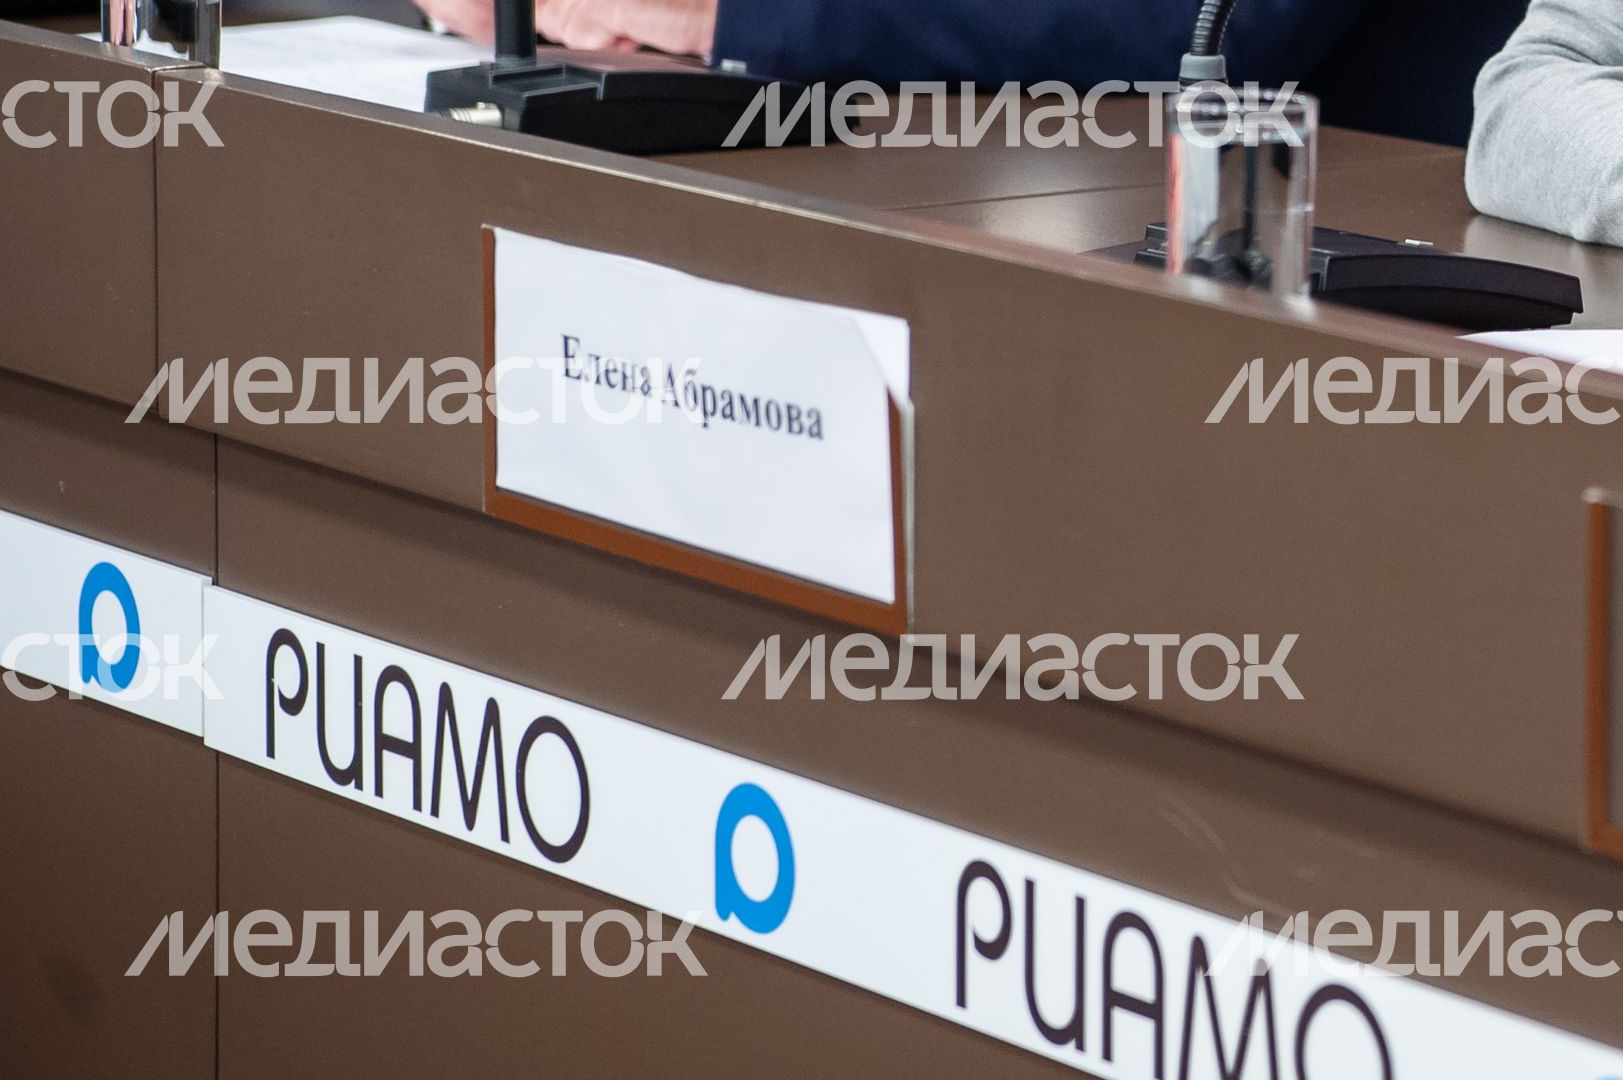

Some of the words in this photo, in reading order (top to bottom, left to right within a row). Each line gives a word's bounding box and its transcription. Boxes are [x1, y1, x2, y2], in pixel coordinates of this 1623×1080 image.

[560, 333, 652, 398] Елена
[661, 361, 825, 440] Абрамова
[266, 627, 590, 864] РИАМО
